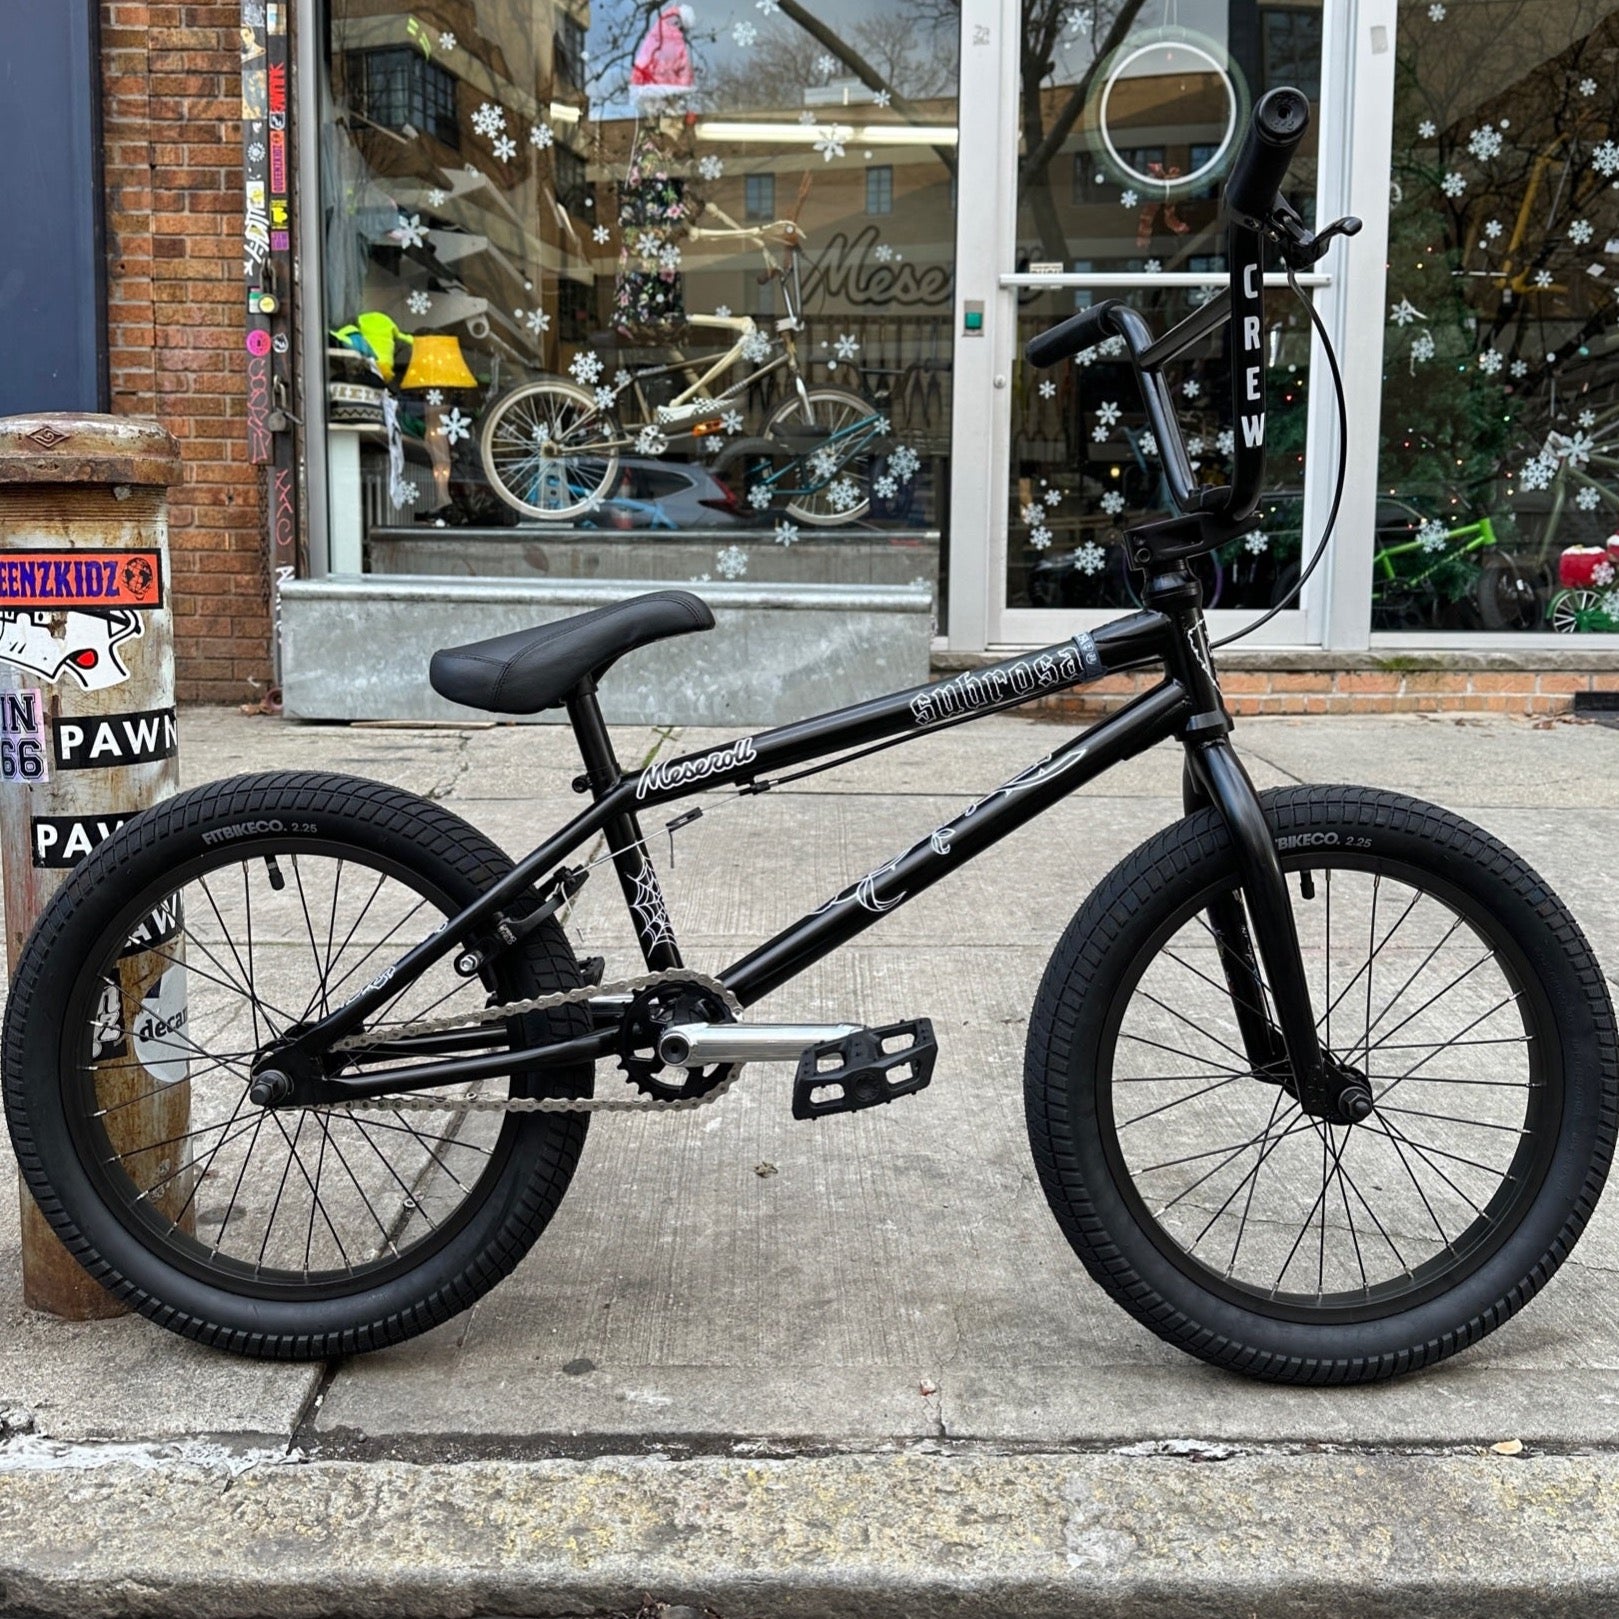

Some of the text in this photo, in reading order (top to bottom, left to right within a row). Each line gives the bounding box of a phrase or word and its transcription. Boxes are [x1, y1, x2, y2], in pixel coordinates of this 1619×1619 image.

[1241, 263, 1265, 448] CREW
[910, 646, 1085, 726] subrosa
[59, 714, 178, 760] PAWN
[636, 737, 757, 800] Meseroll
[201, 819, 318, 846] FITBIKECO. 2.25
[1275, 831, 1373, 851] BIKECO. 2.25
